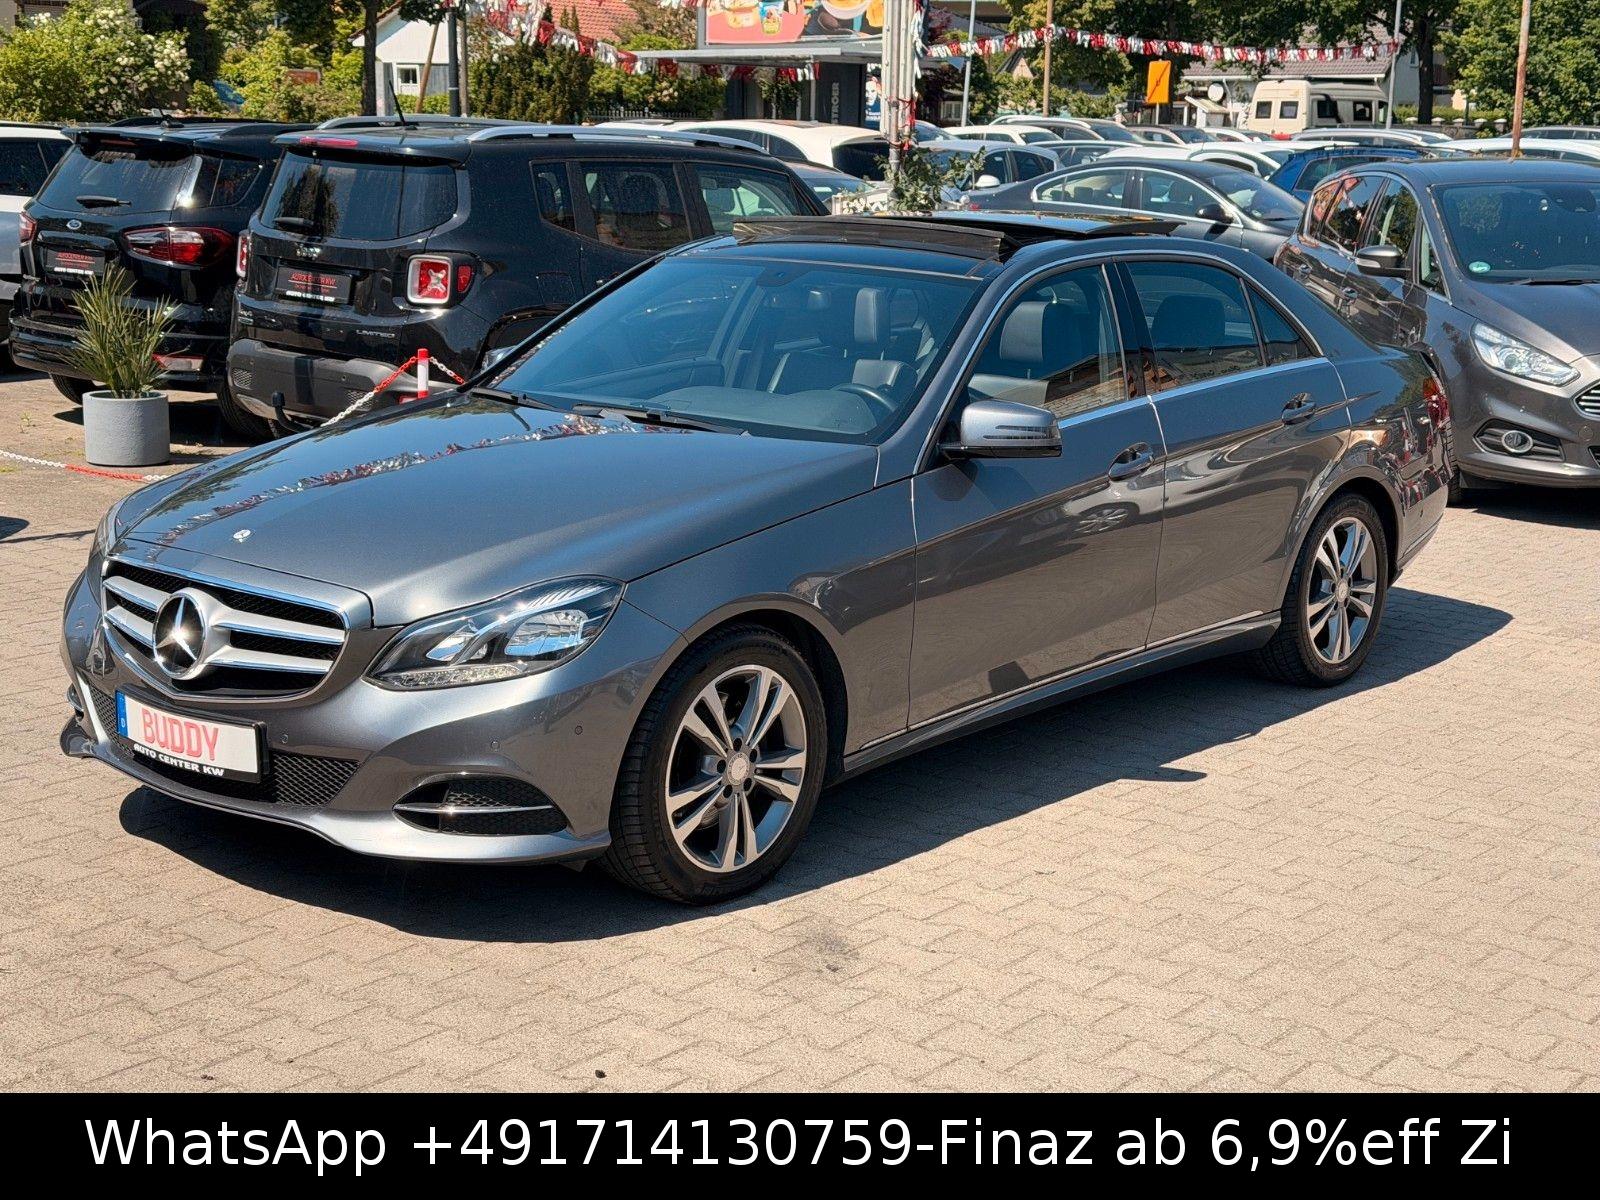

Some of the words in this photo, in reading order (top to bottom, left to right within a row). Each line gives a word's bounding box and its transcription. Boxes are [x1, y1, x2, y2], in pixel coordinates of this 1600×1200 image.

[141, 707, 219, 761] BUDDY
[133, 743, 157, 758] AUTO
[158, 753, 200, 772] CENTER
[203, 765, 225, 777] KW
